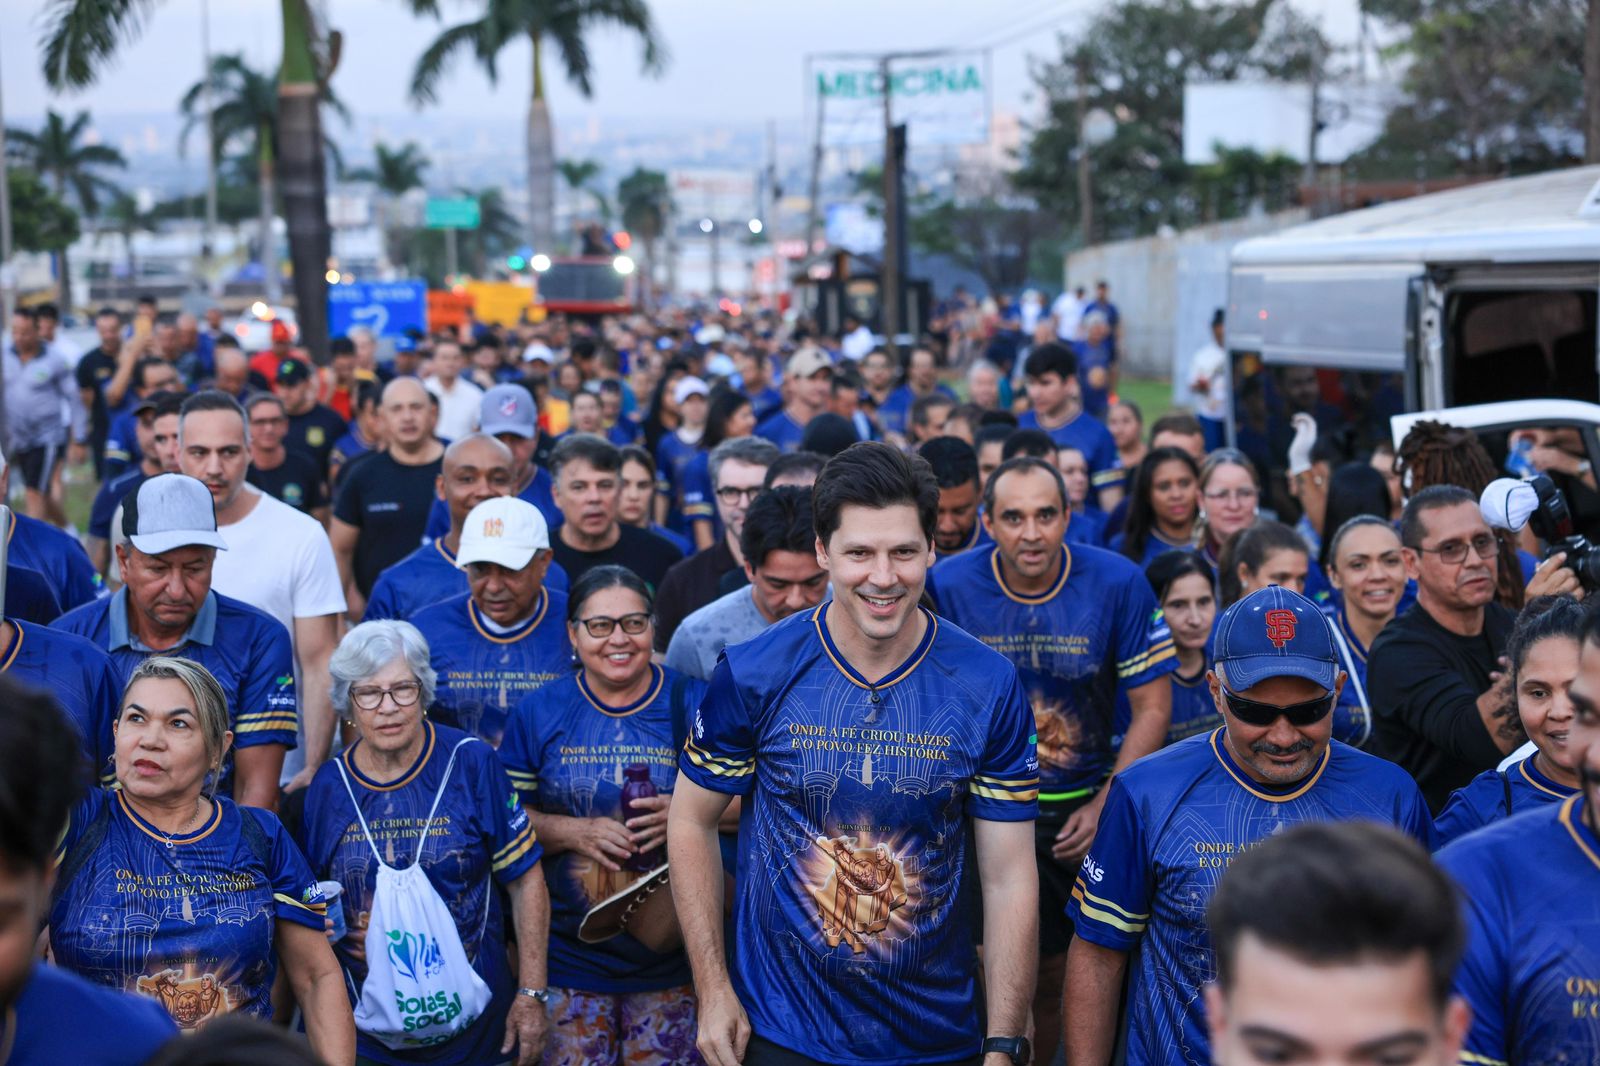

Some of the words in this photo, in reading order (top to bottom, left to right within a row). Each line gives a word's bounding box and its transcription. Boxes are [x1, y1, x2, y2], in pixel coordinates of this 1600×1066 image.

[816, 66, 981, 99] MEDICINA
[789, 722, 826, 736] ONDE
[829, 728, 838, 738] A
[841, 725, 857, 739] FÉ
[860, 729, 905, 743] CRIOU
[906, 731, 951, 747] RAÍZES
[791, 738, 800, 749] E
[803, 738, 813, 750] O
[816, 739, 853, 753] POVO
[856, 743, 882, 755] FEZ
[884, 744, 950, 761] HISTÓRIA.
[383, 817, 413, 829] CRIOU
[380, 829, 400, 840] FEZ
[1194, 842, 1235, 854] ONDE
[1083, 854, 1105, 882] OIÁS
[1199, 857, 1209, 867] E
[1211, 857, 1222, 867] O
[157, 872, 173, 886] FÉ
[116, 882, 125, 893] E
[126, 883, 137, 893] O
[173, 885, 199, 898] FEZ
